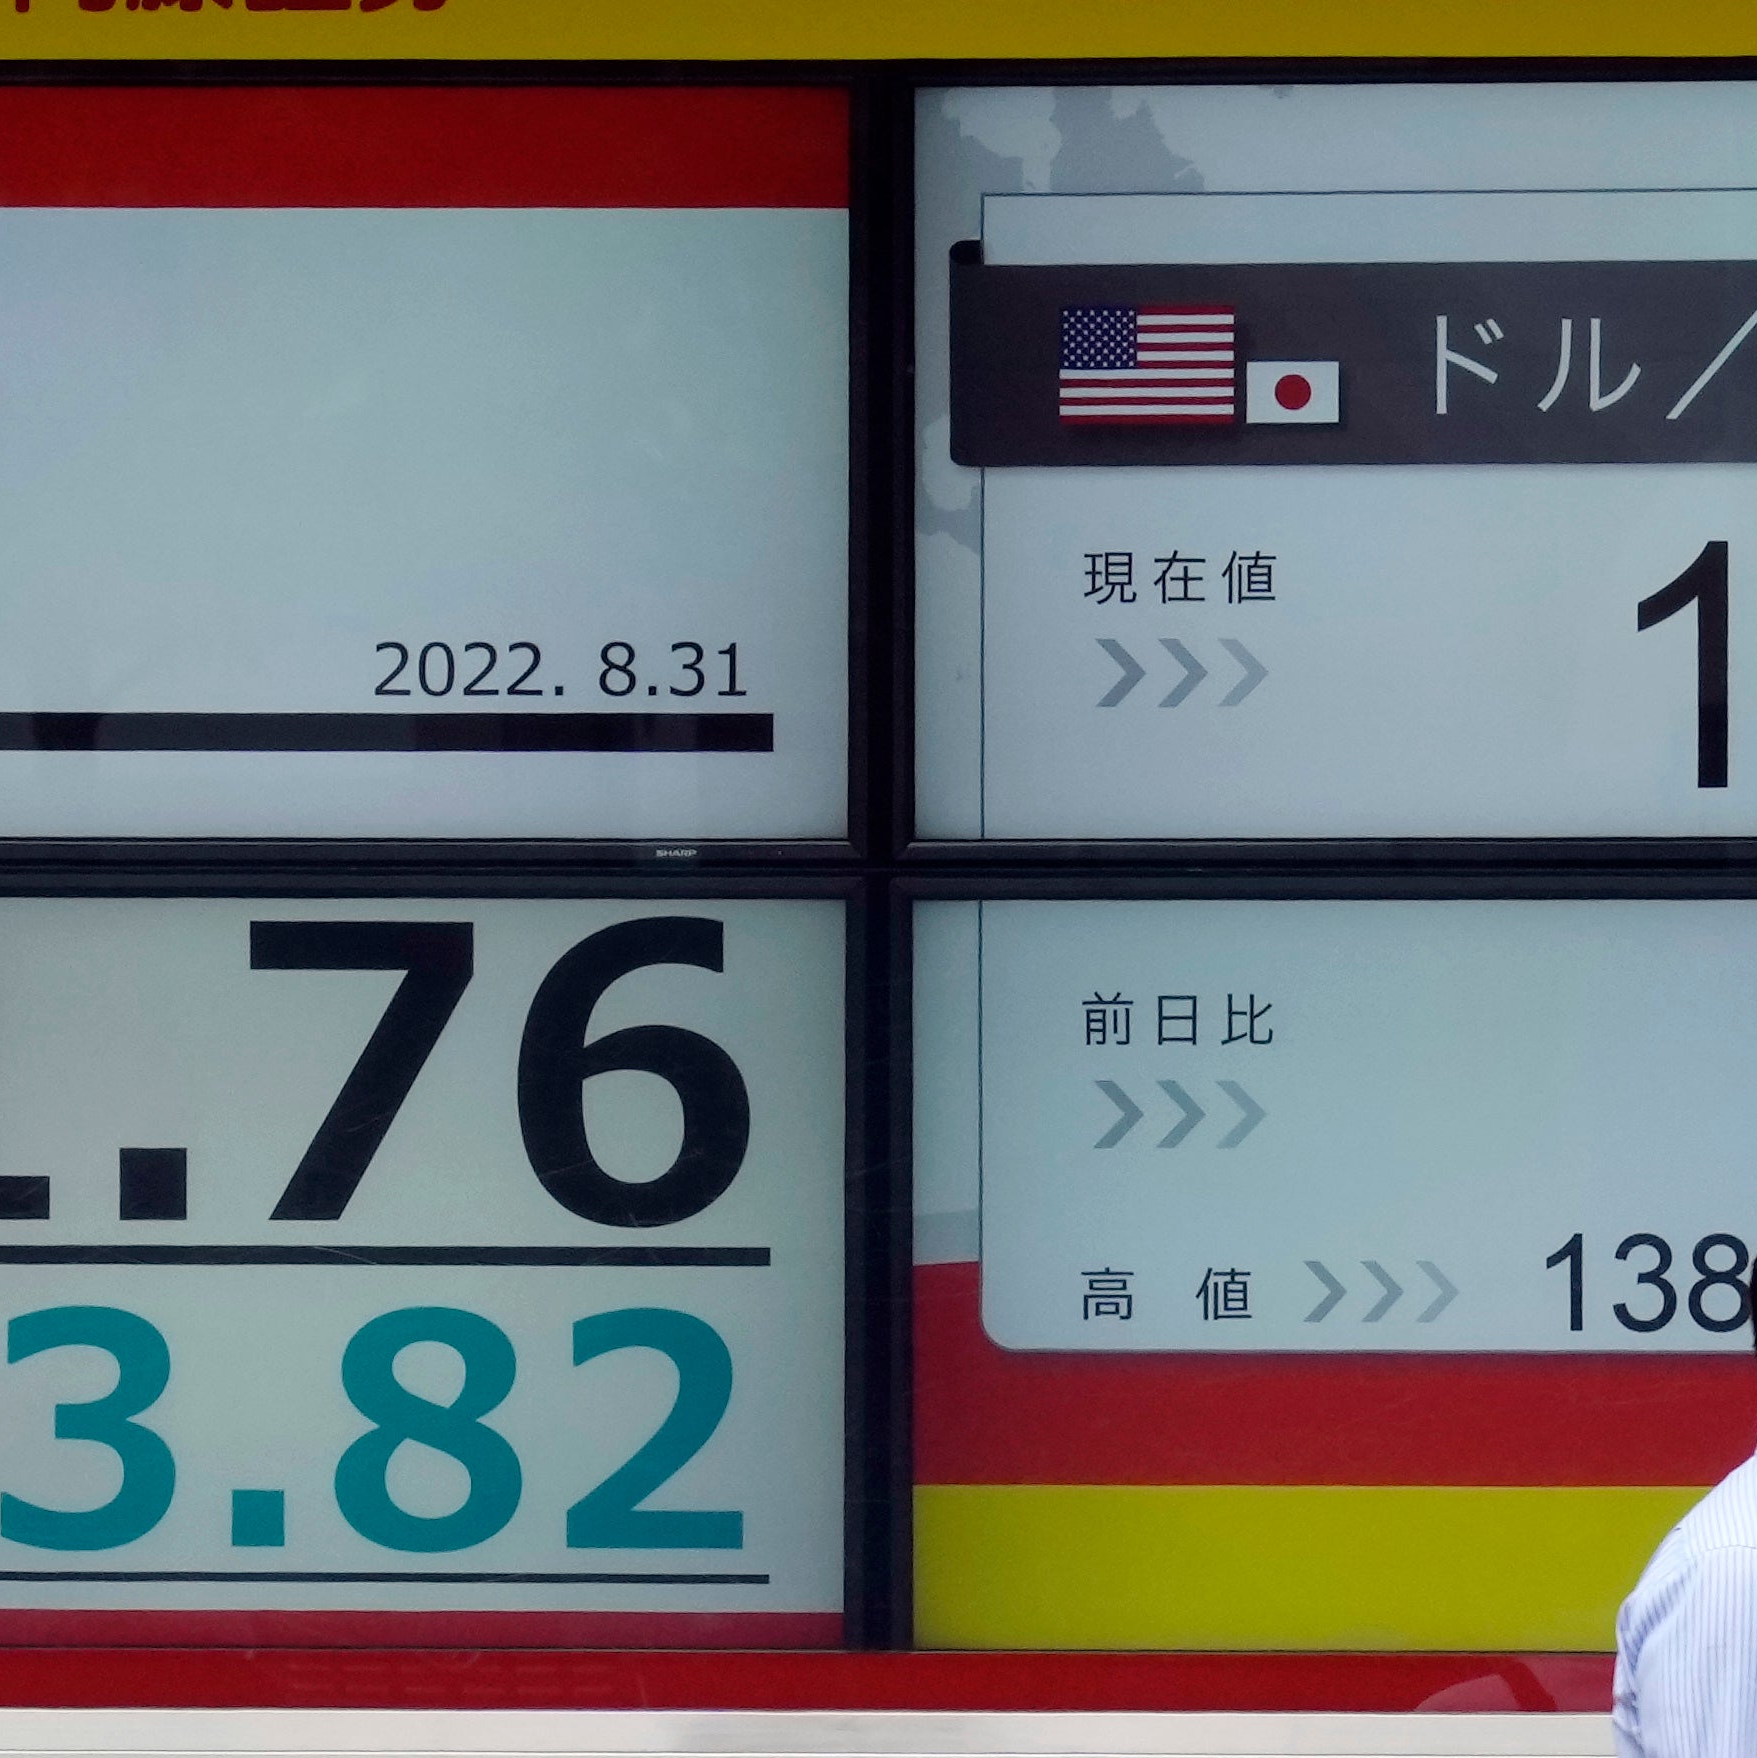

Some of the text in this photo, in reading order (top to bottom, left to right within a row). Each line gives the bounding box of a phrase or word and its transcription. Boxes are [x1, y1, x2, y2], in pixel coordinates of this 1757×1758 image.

[1083, 549, 1277, 605] 現在値
[1081, 991, 1275, 1047] 前日比
